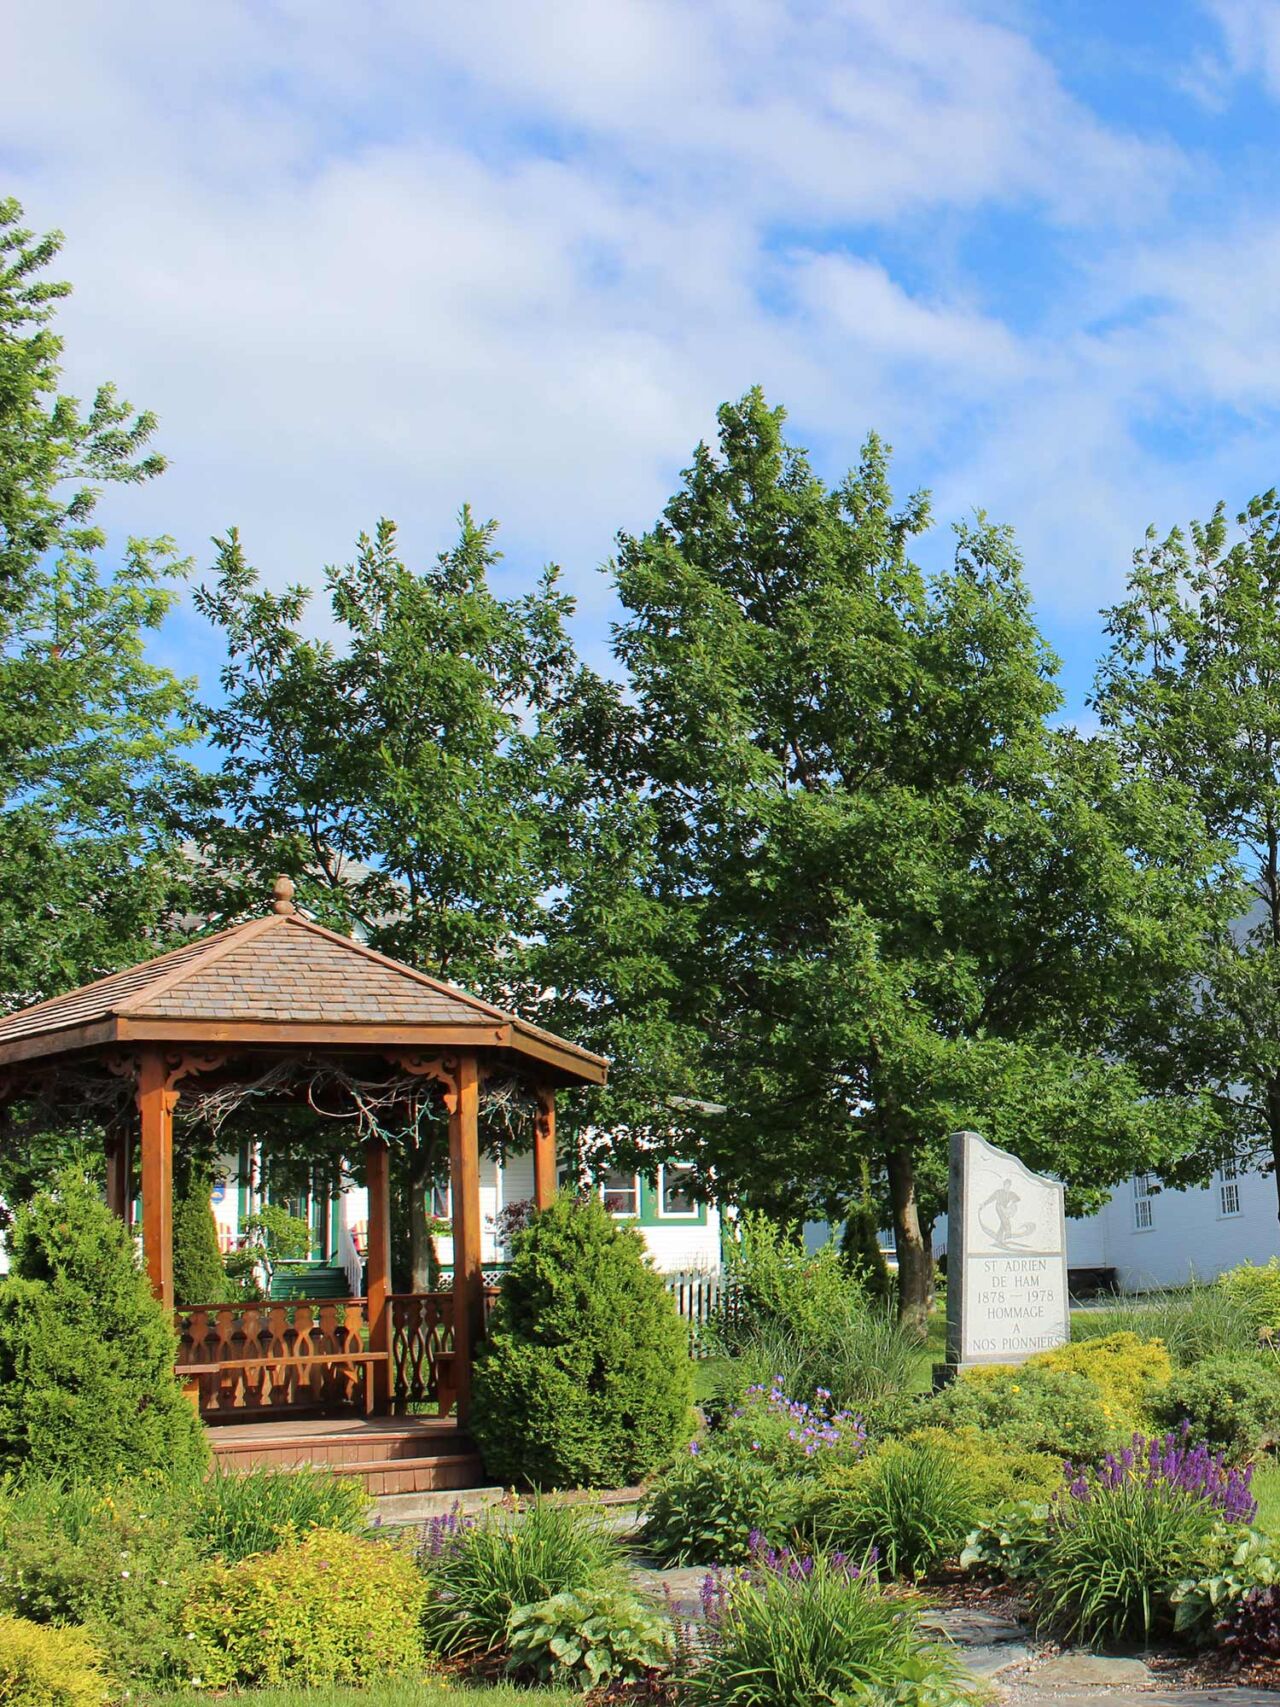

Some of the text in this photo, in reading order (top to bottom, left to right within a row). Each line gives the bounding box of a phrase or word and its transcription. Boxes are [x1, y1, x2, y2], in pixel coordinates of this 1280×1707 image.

[984, 1260, 1047, 1272] ST ADRIEN
[992, 1275, 1040, 1288] DE HAM
[978, 1291, 1005, 1304] 1878
[1027, 1290, 1054, 1303] 1978
[988, 1306, 1045, 1319] HOMMAGE
[973, 1336, 1061, 1351] NOS PIONNIERS
